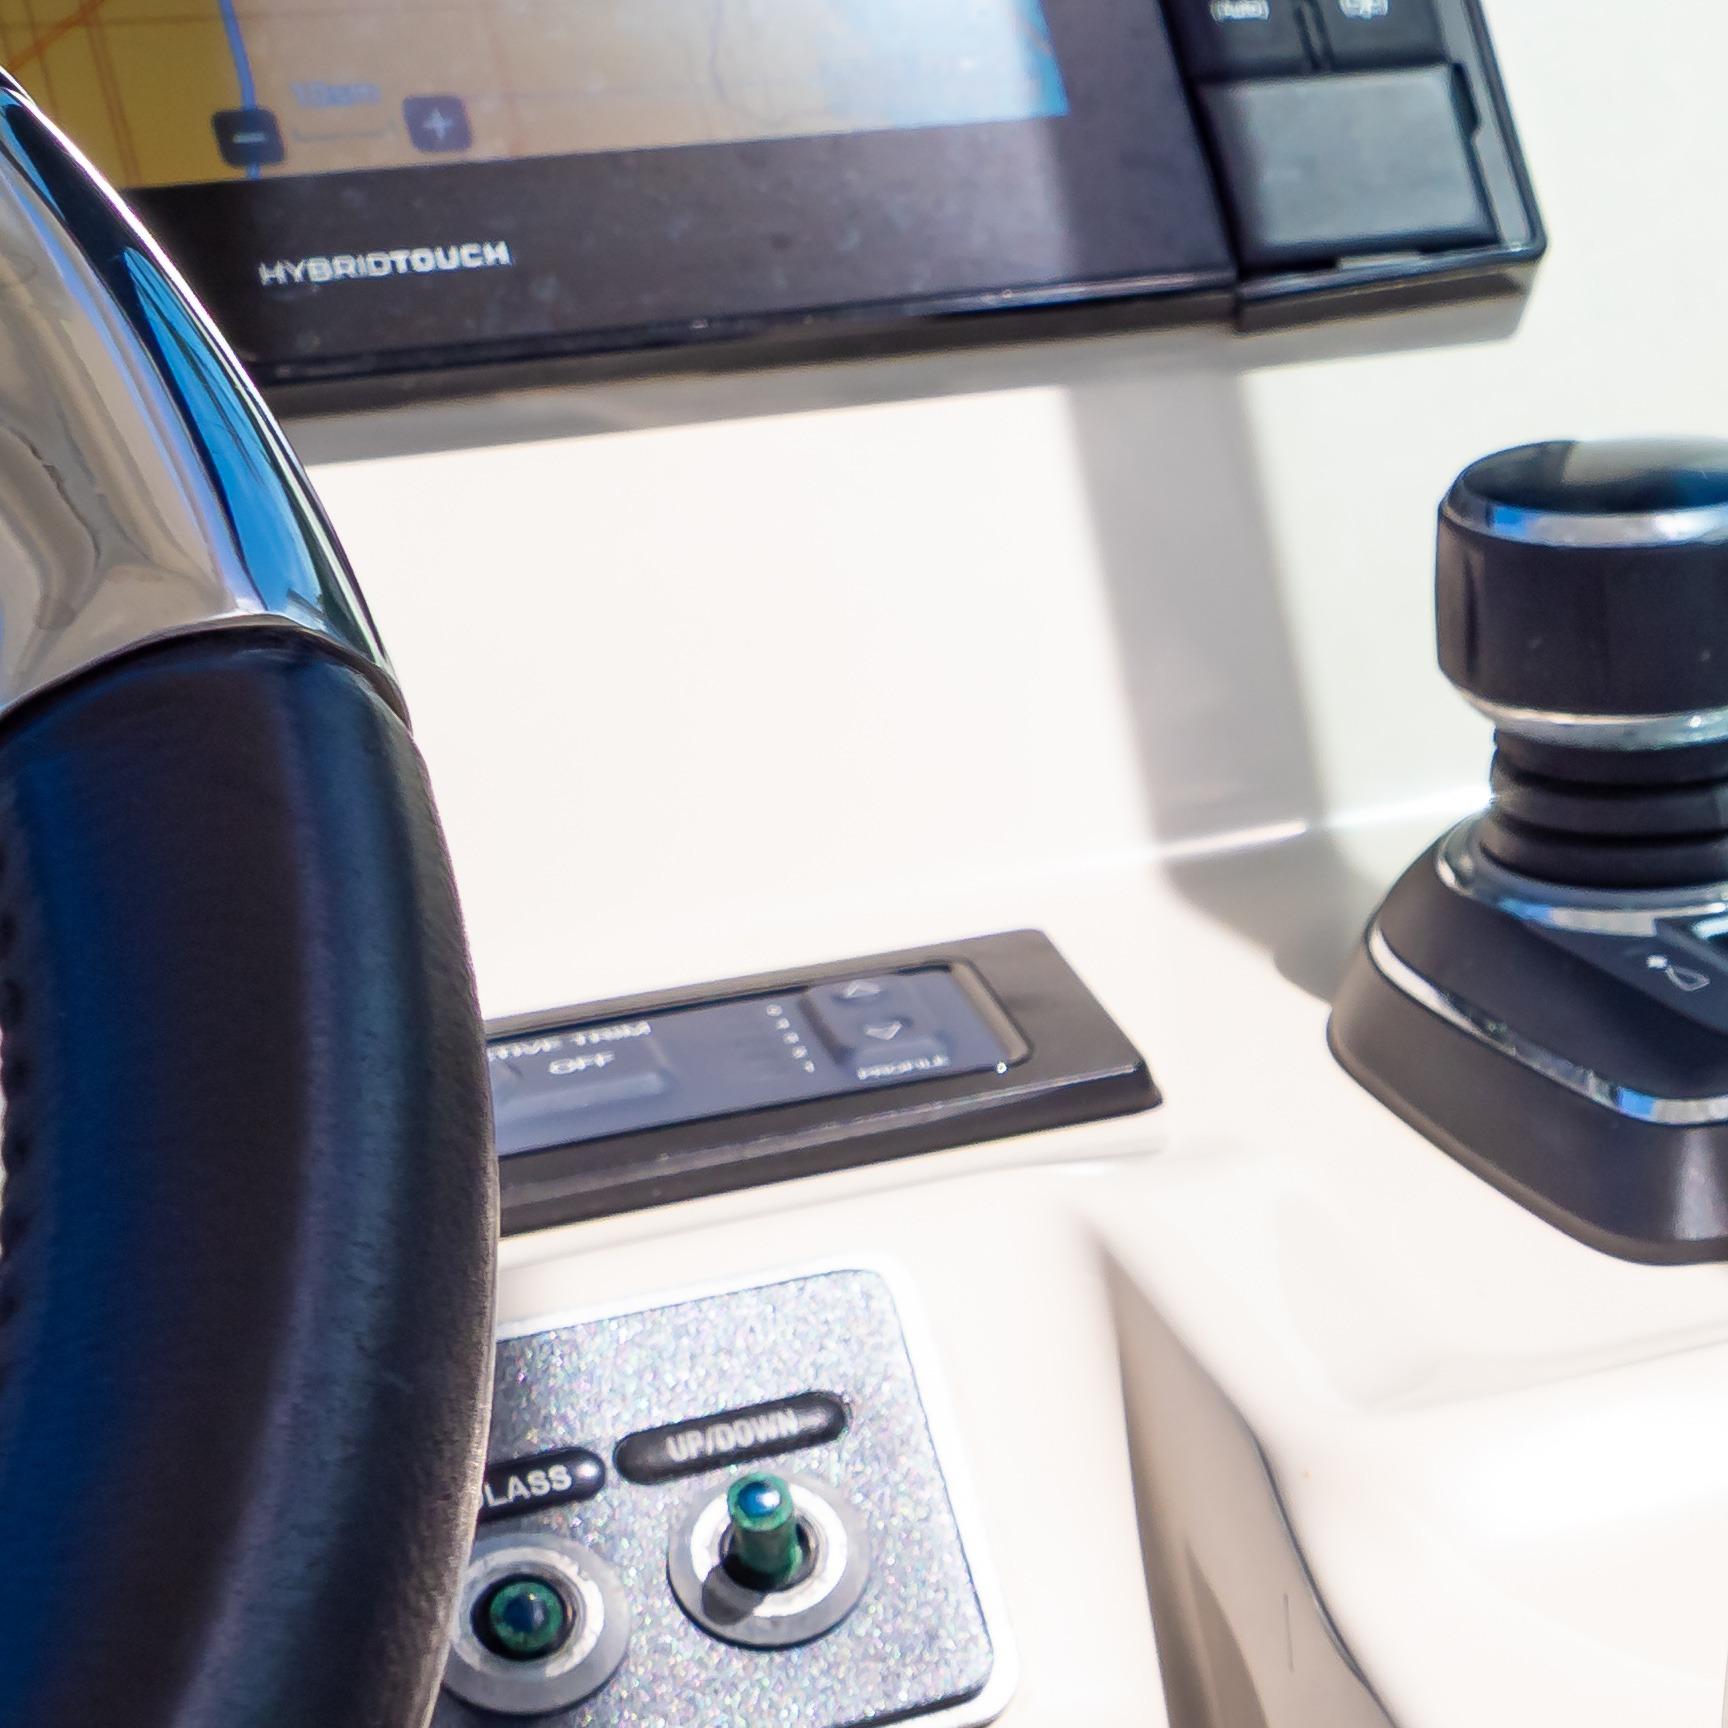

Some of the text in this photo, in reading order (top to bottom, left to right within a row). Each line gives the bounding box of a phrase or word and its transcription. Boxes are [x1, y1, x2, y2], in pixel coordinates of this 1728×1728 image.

[258, 241, 511, 286] HYBRIDTOUCH
[665, 1408, 798, 1464] UP/DOWN
[483, 1463, 572, 1508] LASS
